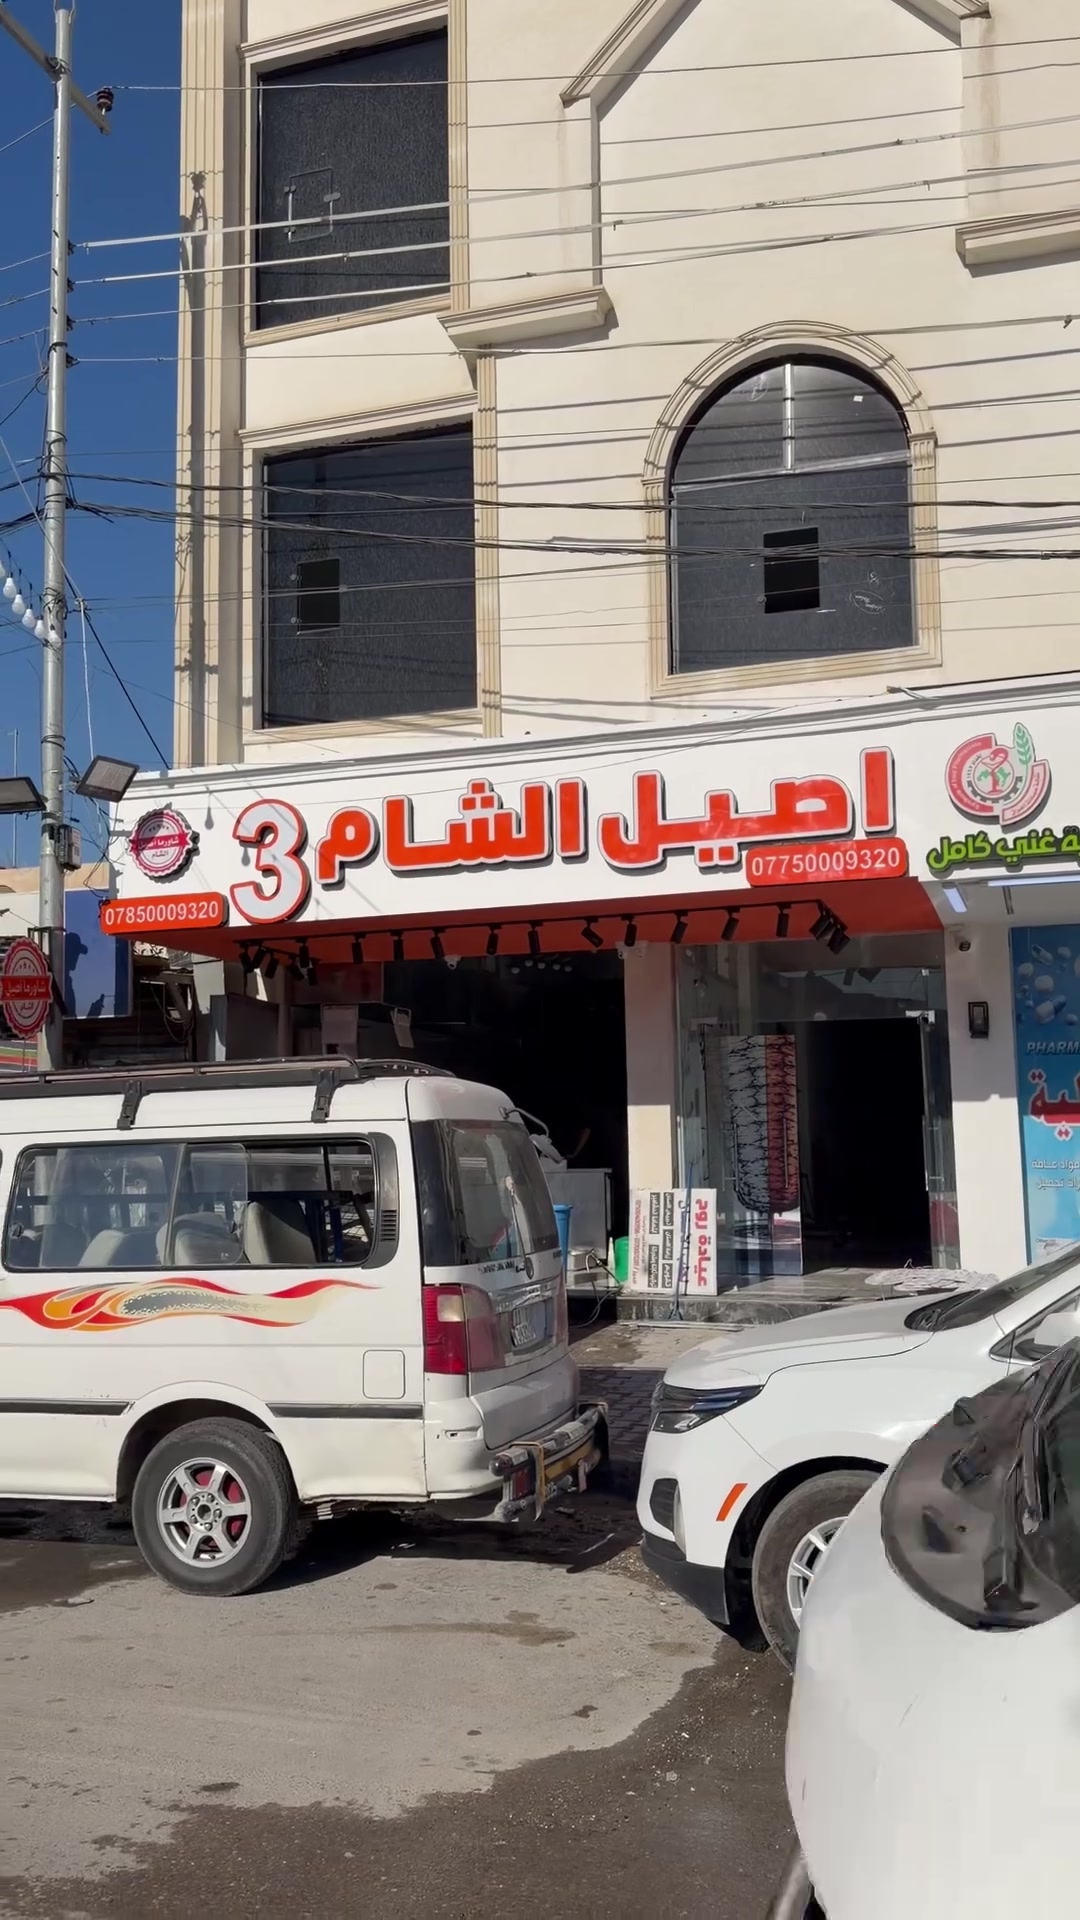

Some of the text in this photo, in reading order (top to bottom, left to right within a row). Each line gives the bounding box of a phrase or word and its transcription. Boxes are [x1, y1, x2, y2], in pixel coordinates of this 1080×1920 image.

[230, 747, 895, 923] اصيل الشام 3
[927, 831, 992, 870] كامل
[995, 828, 1057, 864] غني
[752, 847, 900, 876] 07750009320
[105, 901, 219, 926] 07850009320
[1026, 1041, 1080, 1055] PHARM
[694, 1198, 711, 1287] عيادة روح
